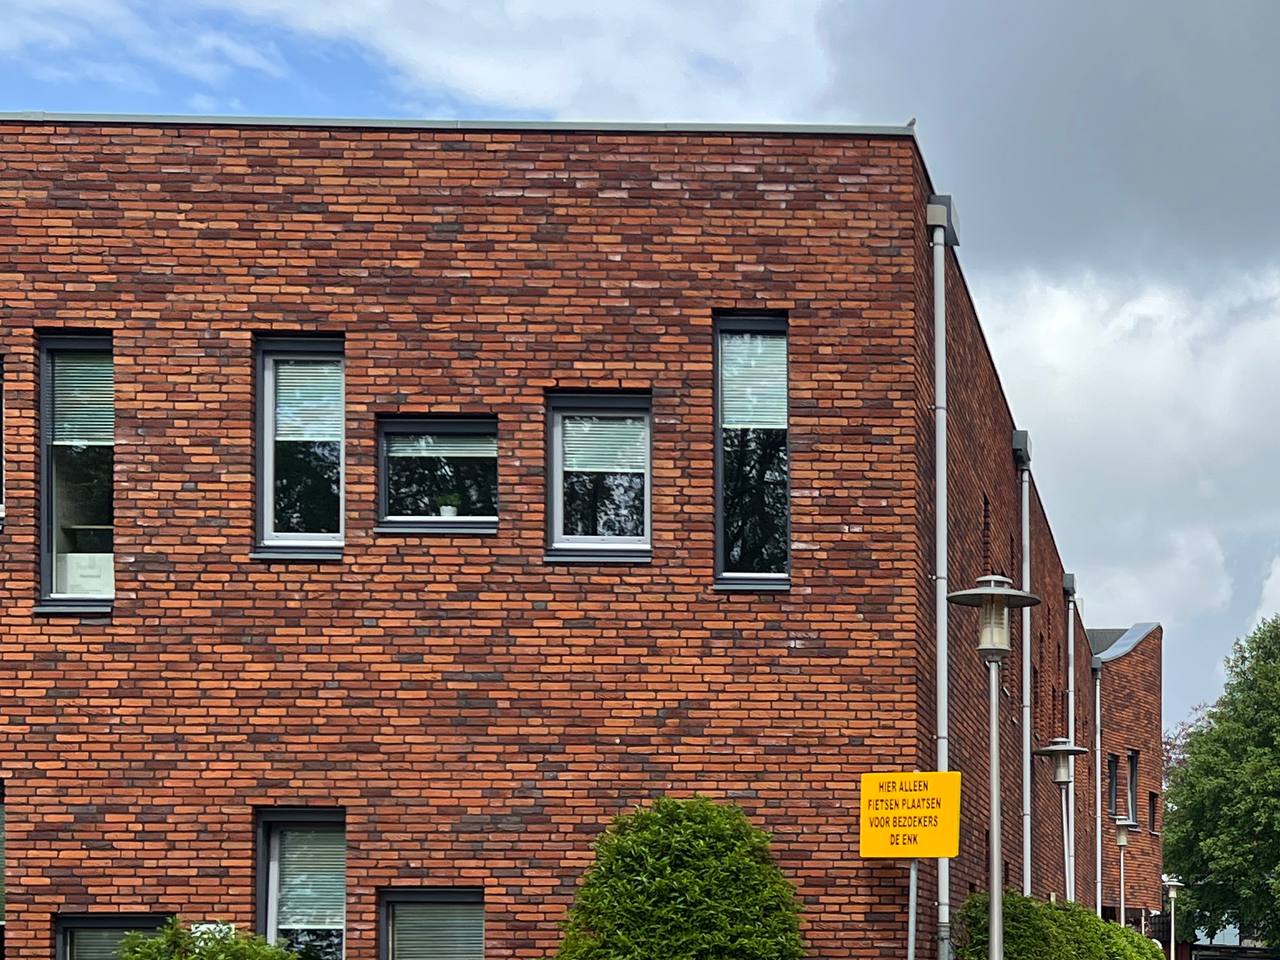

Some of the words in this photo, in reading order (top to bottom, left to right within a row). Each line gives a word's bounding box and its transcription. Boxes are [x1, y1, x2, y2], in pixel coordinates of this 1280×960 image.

[879, 781, 897, 793] HIER
[899, 780, 929, 792] ALLEEN
[868, 799, 899, 811] FIETSEN
[901, 797, 941, 810] PLAATSEN
[869, 816, 890, 828] VOOR
[892, 815, 938, 828] BEZOEKERS
[890, 833, 899, 846] DE
[902, 833, 918, 846] ENK
